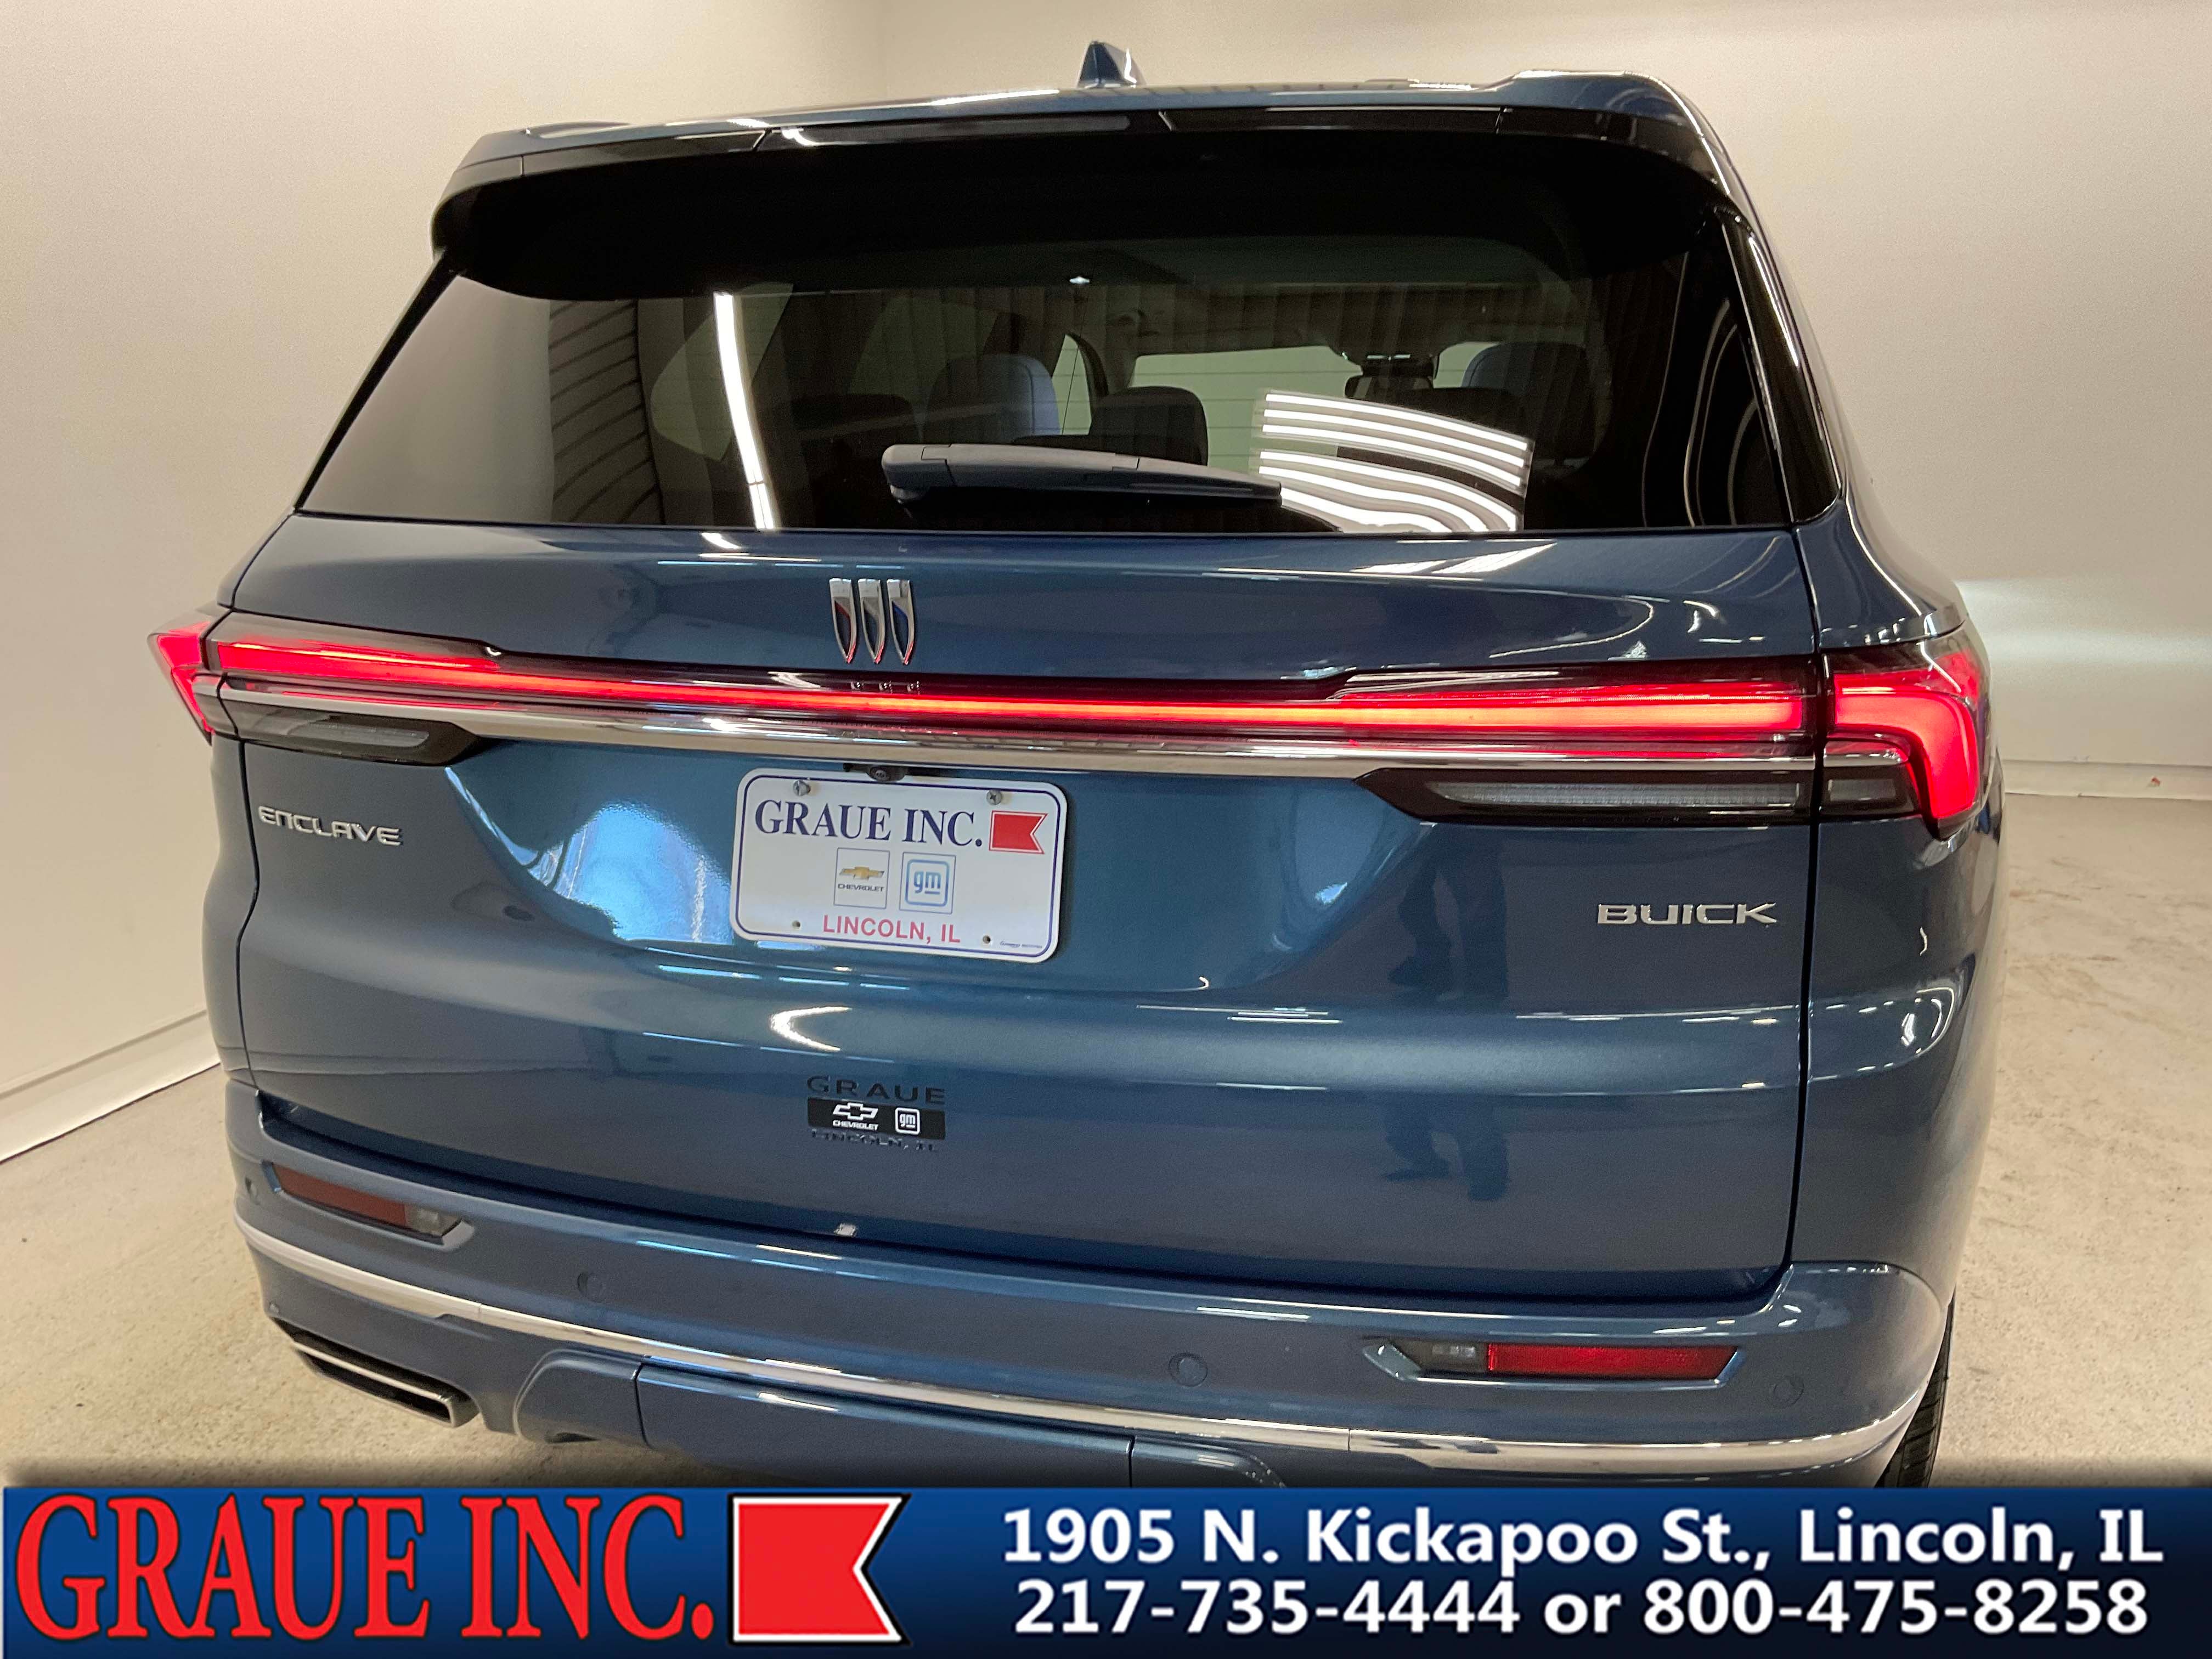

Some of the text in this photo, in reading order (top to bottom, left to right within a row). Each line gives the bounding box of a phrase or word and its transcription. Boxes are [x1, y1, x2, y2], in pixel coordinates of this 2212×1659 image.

[258, 806, 403, 846] ENCLAVE
[754, 799, 983, 847] GRAUE INC.
[837, 883, 885, 893] CHEVROLET
[913, 871, 942, 895] gm
[1597, 902, 1778, 926] BUICK
[823, 915, 961, 945] LINCOLN, IL
[806, 1075, 946, 1105] GRAUE
[832, 1119, 879, 1131] CHEVROLET
